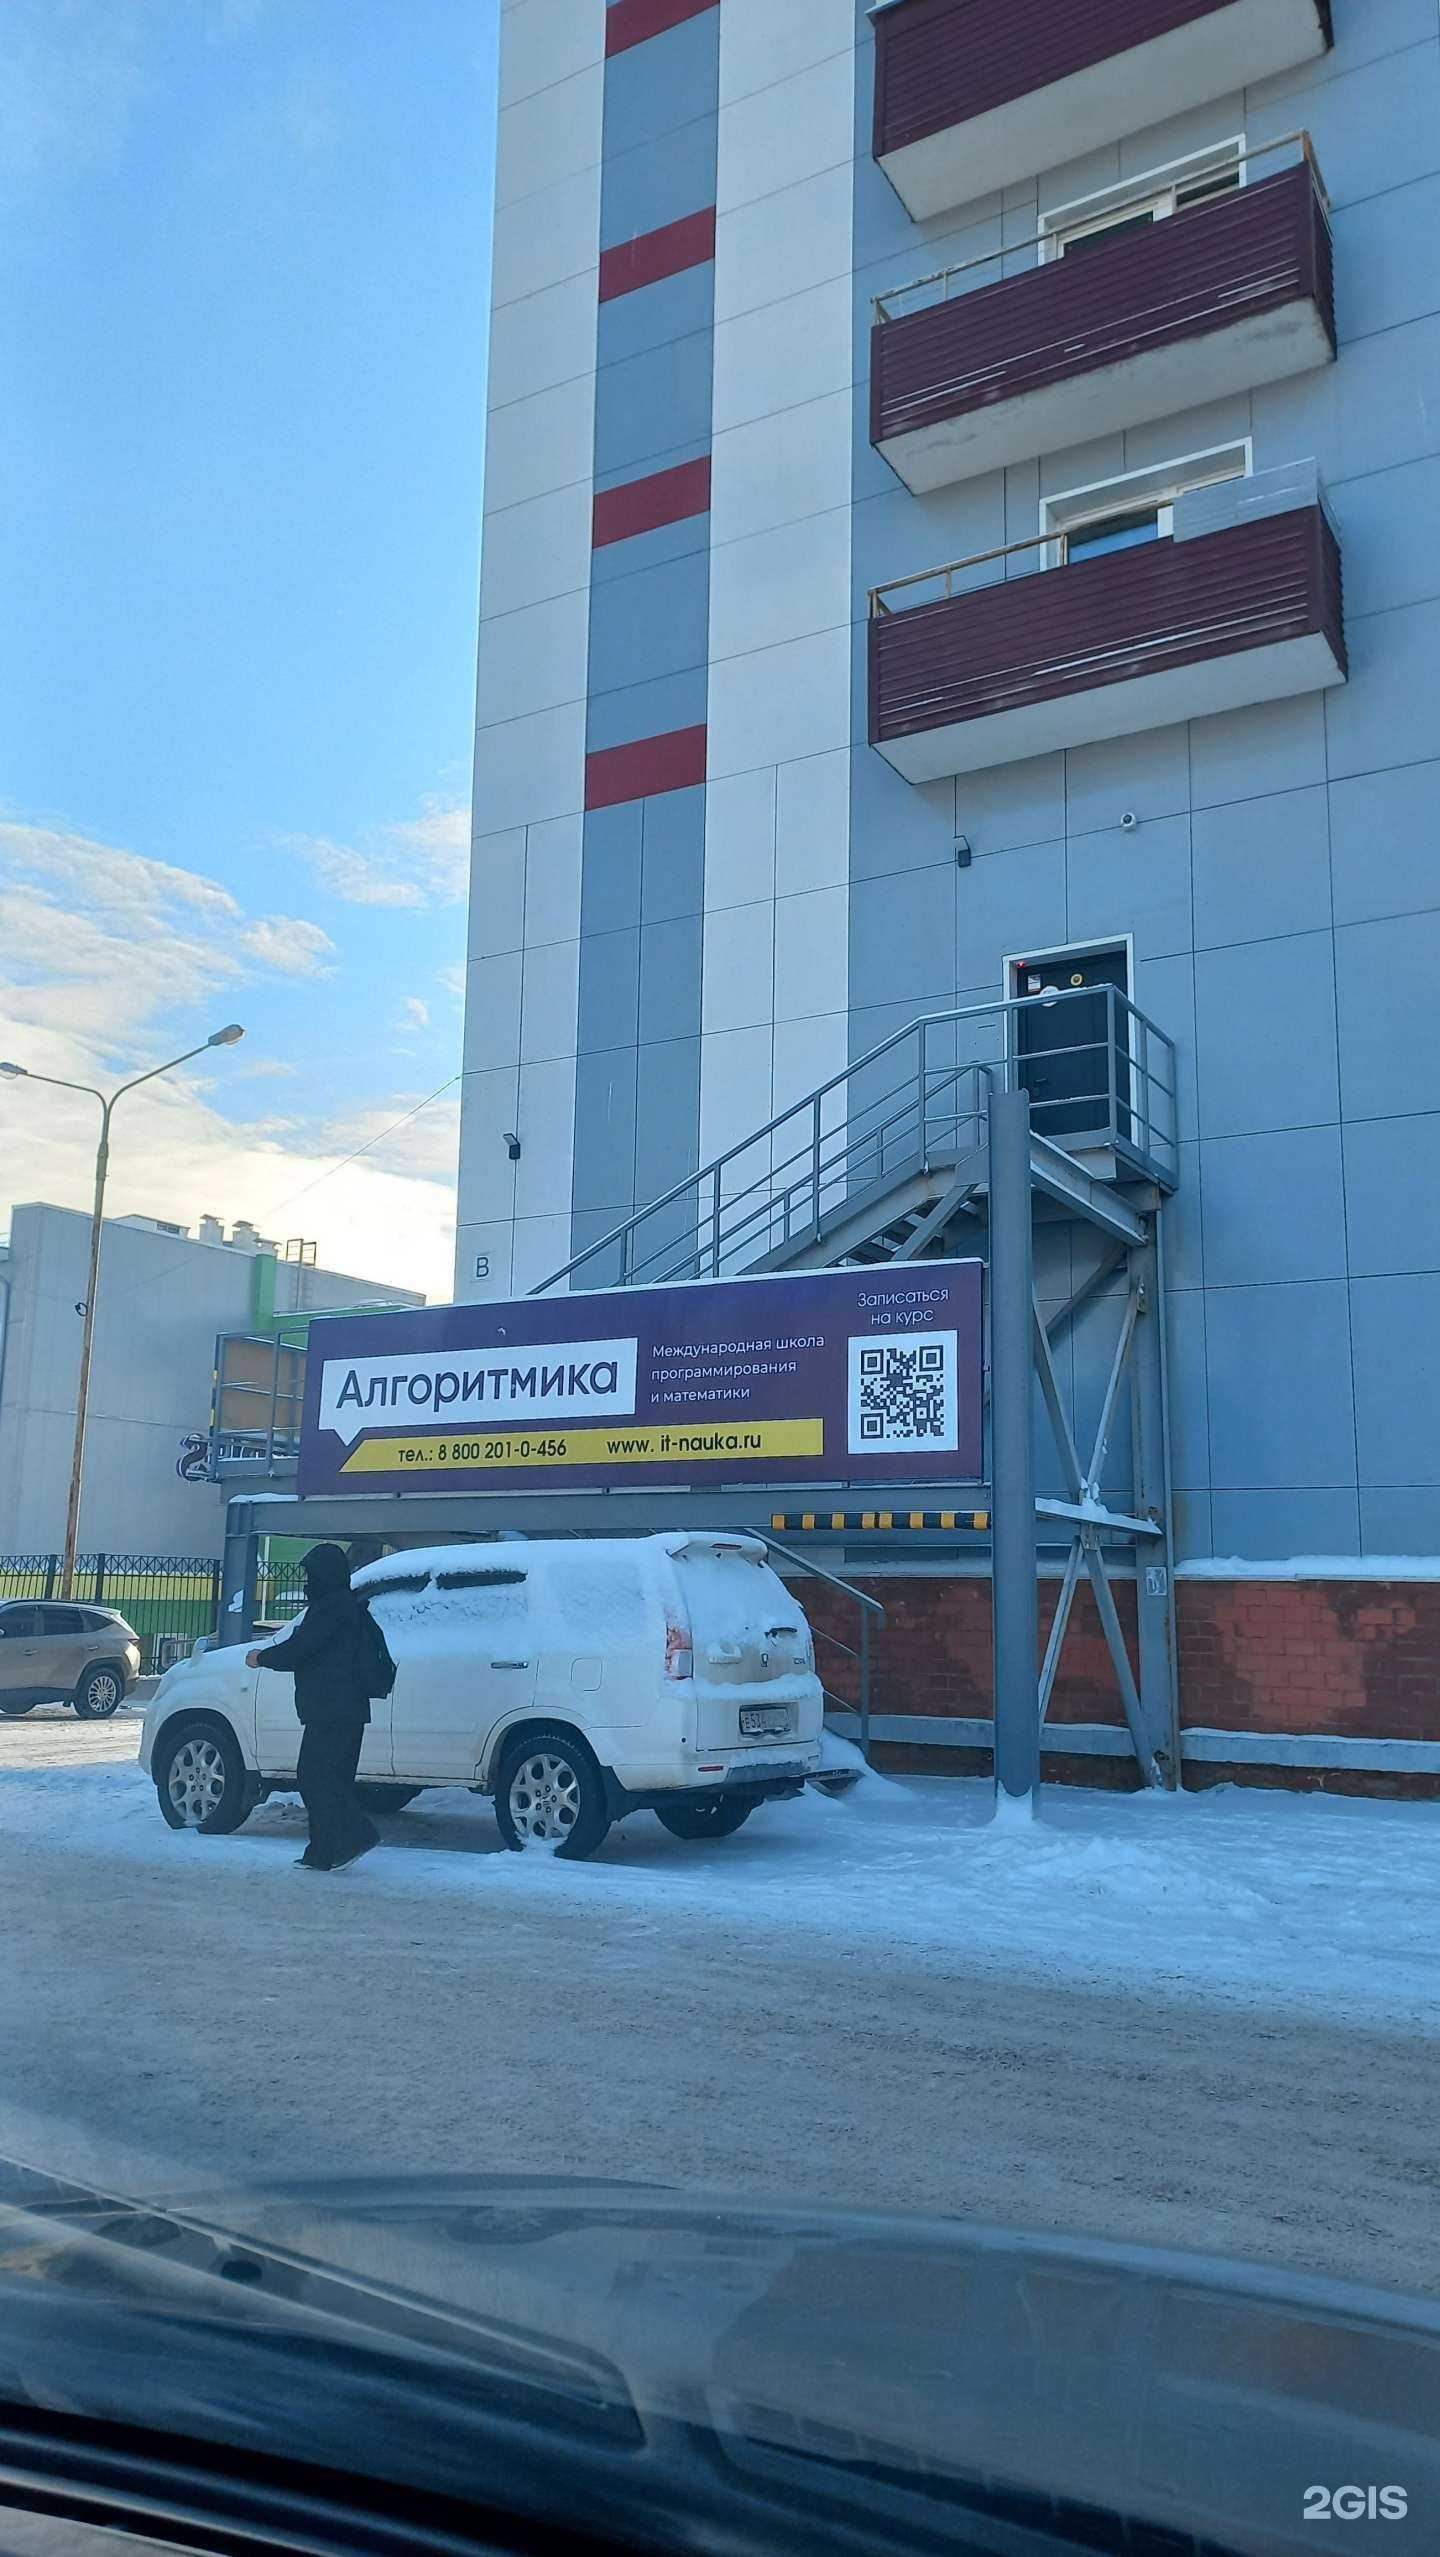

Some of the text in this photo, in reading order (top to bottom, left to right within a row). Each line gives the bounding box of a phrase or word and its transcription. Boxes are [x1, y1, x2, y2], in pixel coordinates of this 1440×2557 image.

[857, 1289, 949, 1307] Записаться
[871, 1309, 934, 1325] на курс
[652, 1336, 825, 1358] Международная школа
[651, 1361, 797, 1382] программирования
[335, 1361, 618, 1413] Алгоритмика
[651, 1387, 750, 1403] и математики
[398, 1438, 567, 1462] тел.: 8 800 201-0-456
[606, 1431, 761, 1454] www. it-nauka.ru
